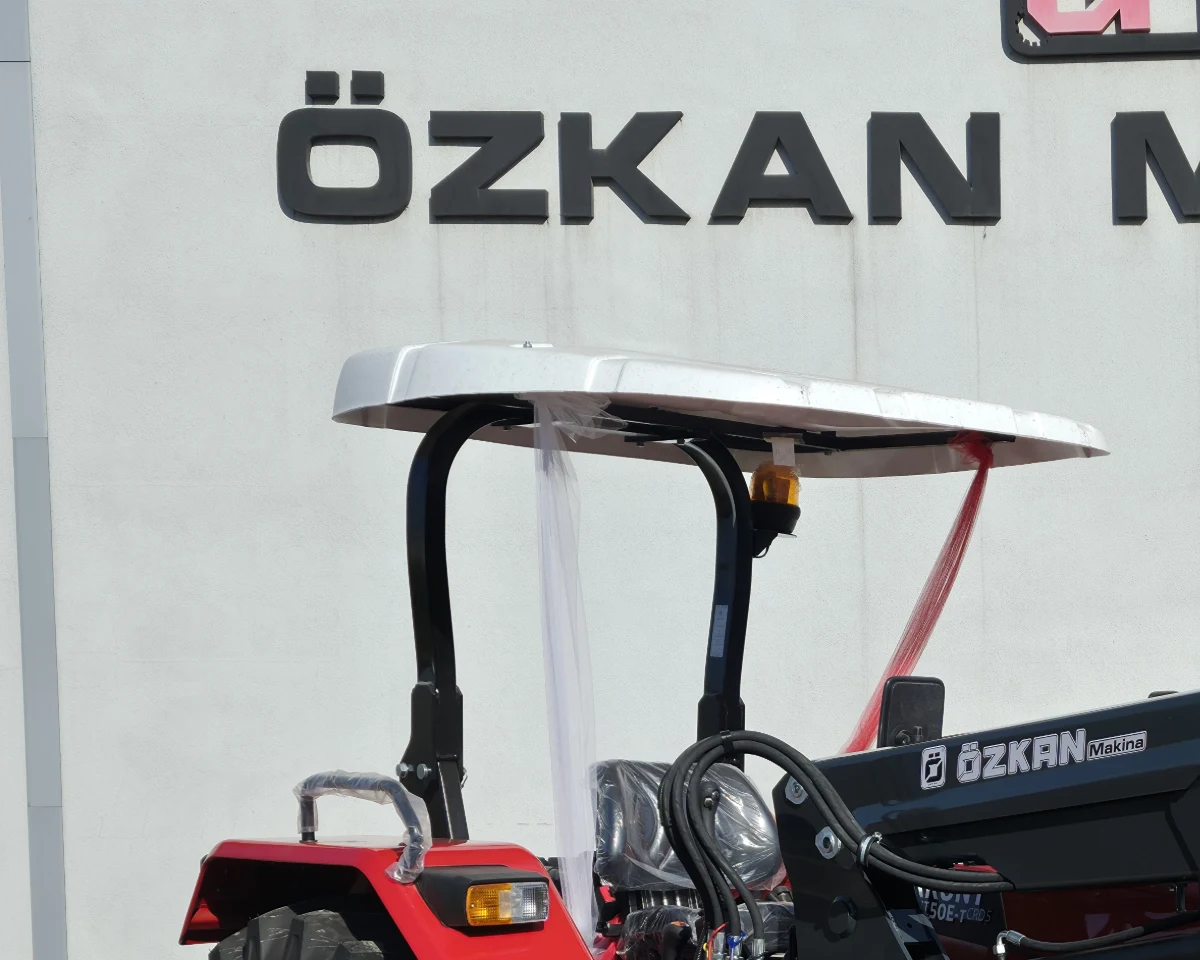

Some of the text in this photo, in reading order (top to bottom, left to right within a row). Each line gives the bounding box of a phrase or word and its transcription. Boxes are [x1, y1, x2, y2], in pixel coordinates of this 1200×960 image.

[277, 70, 1001, 224] ÖZKAN
[956, 728, 1087, 784] ÖZKAN
[1089, 735, 1145, 758] Makina
